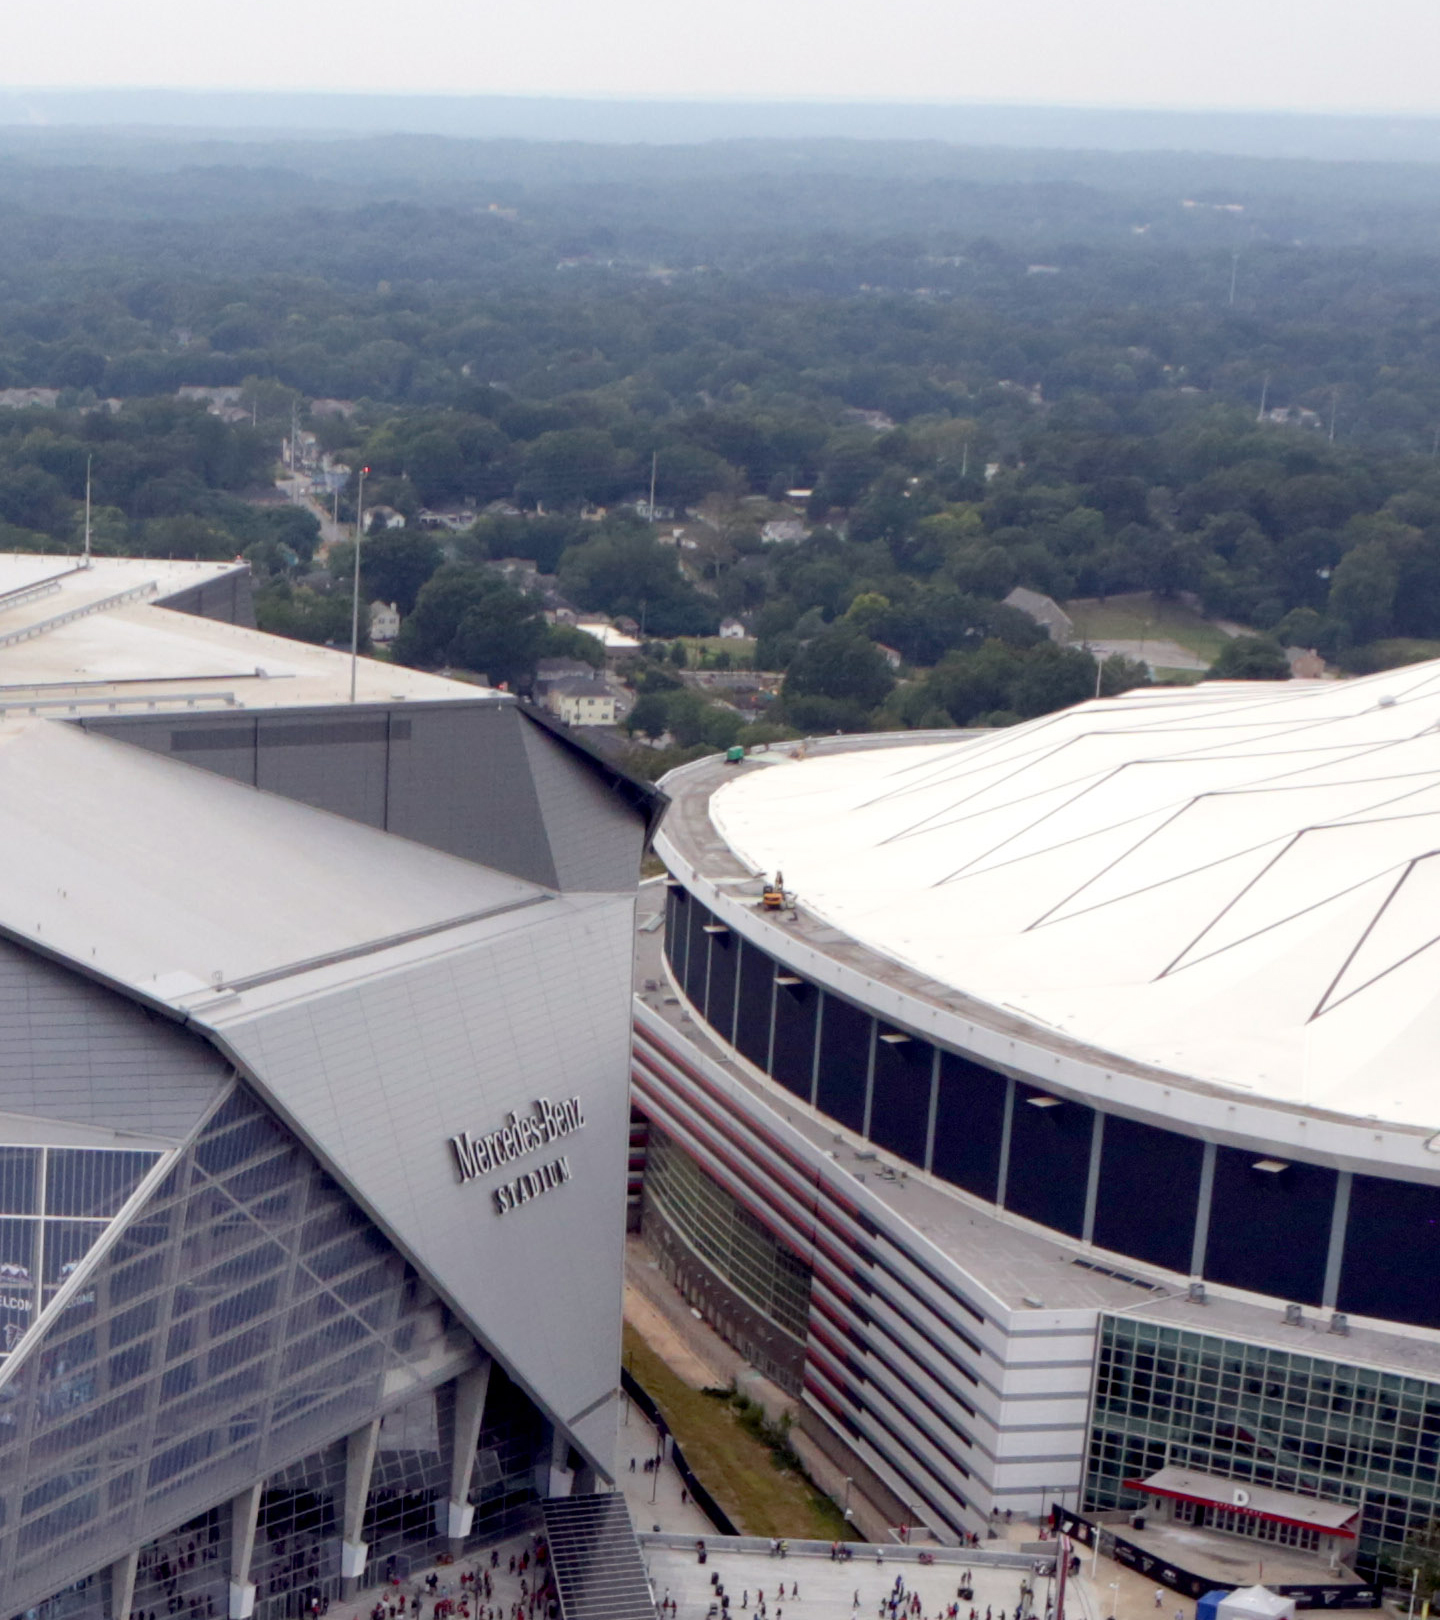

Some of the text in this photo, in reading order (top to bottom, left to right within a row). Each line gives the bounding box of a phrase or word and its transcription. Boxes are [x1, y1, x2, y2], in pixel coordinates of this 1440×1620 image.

[451, 1094, 586, 1184] Mercedes-Benz
[494, 1156, 572, 1216] STADIUM
[1232, 1488, 1250, 1507] D
